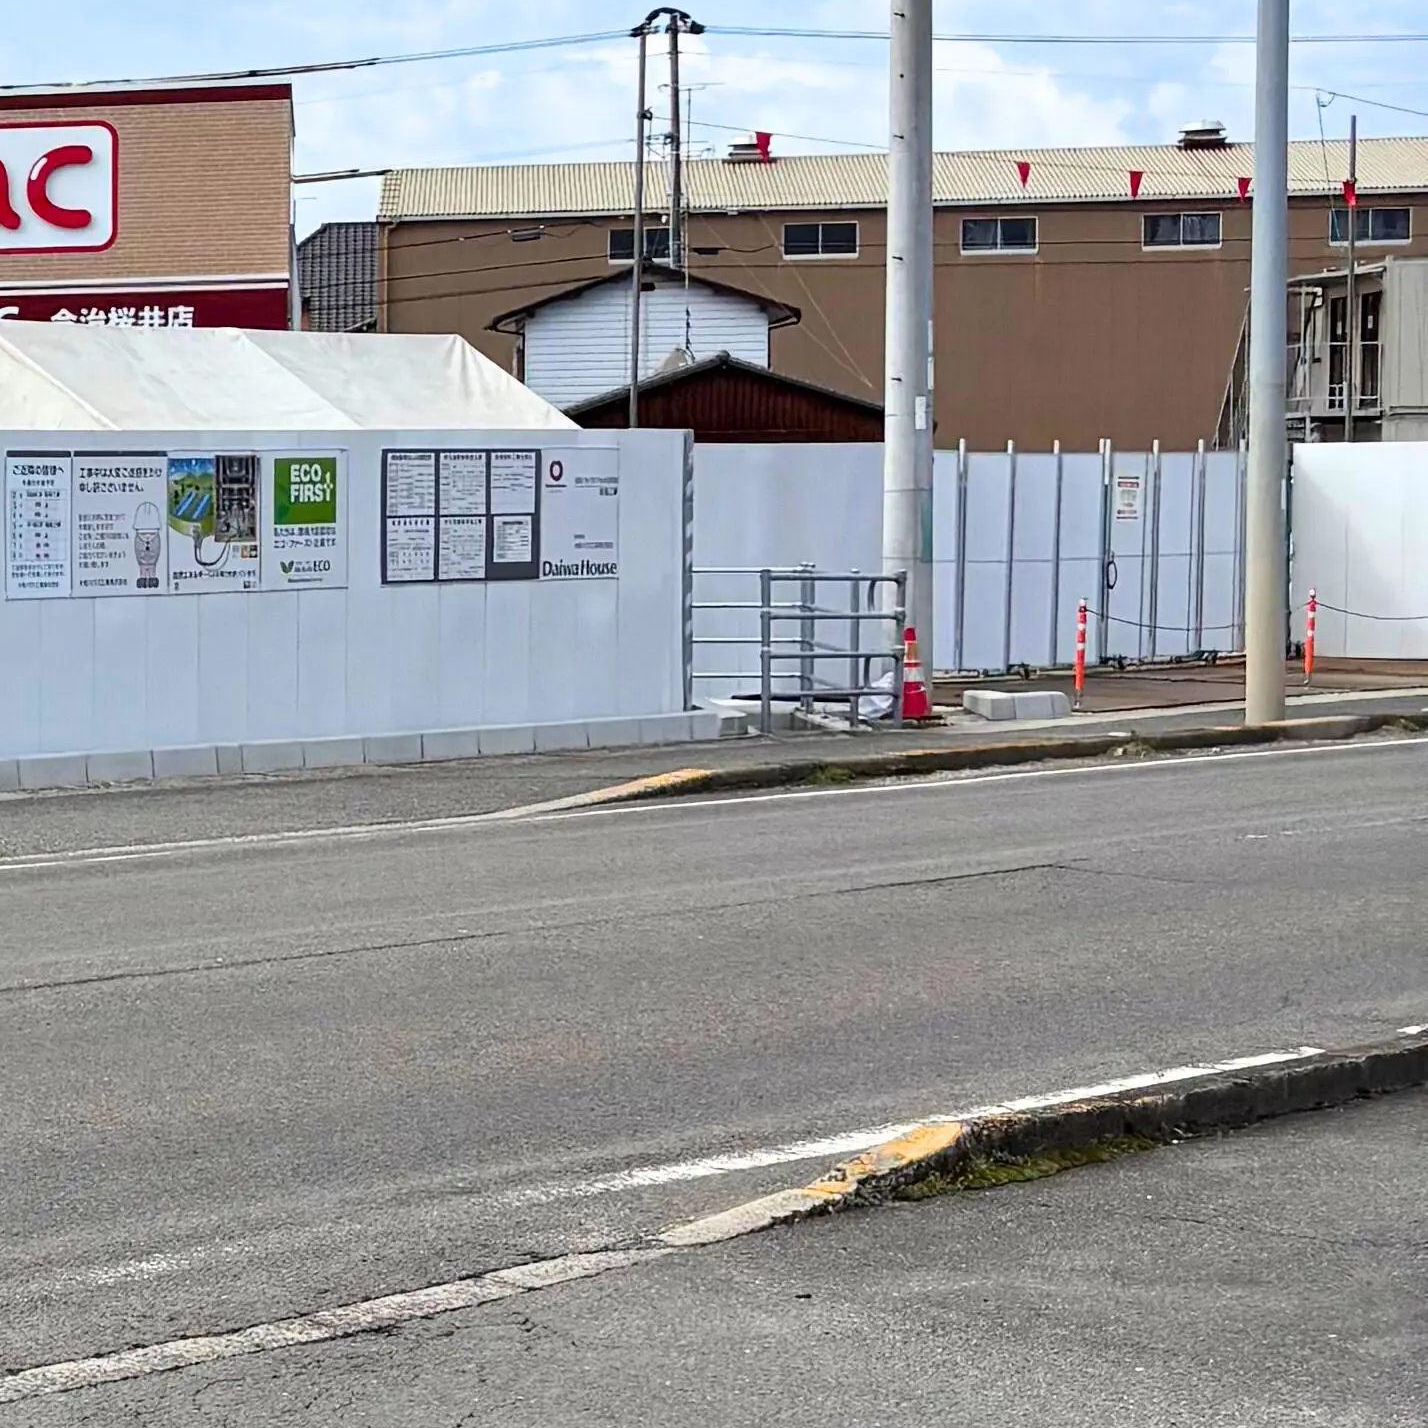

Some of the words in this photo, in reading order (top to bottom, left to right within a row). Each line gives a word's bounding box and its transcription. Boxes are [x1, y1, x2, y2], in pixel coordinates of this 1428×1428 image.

[290, 464, 322, 483] ECO
[290, 476, 333, 503] FIRST
[543, 559, 579, 577] Daiwa
[581, 559, 617, 575] House
